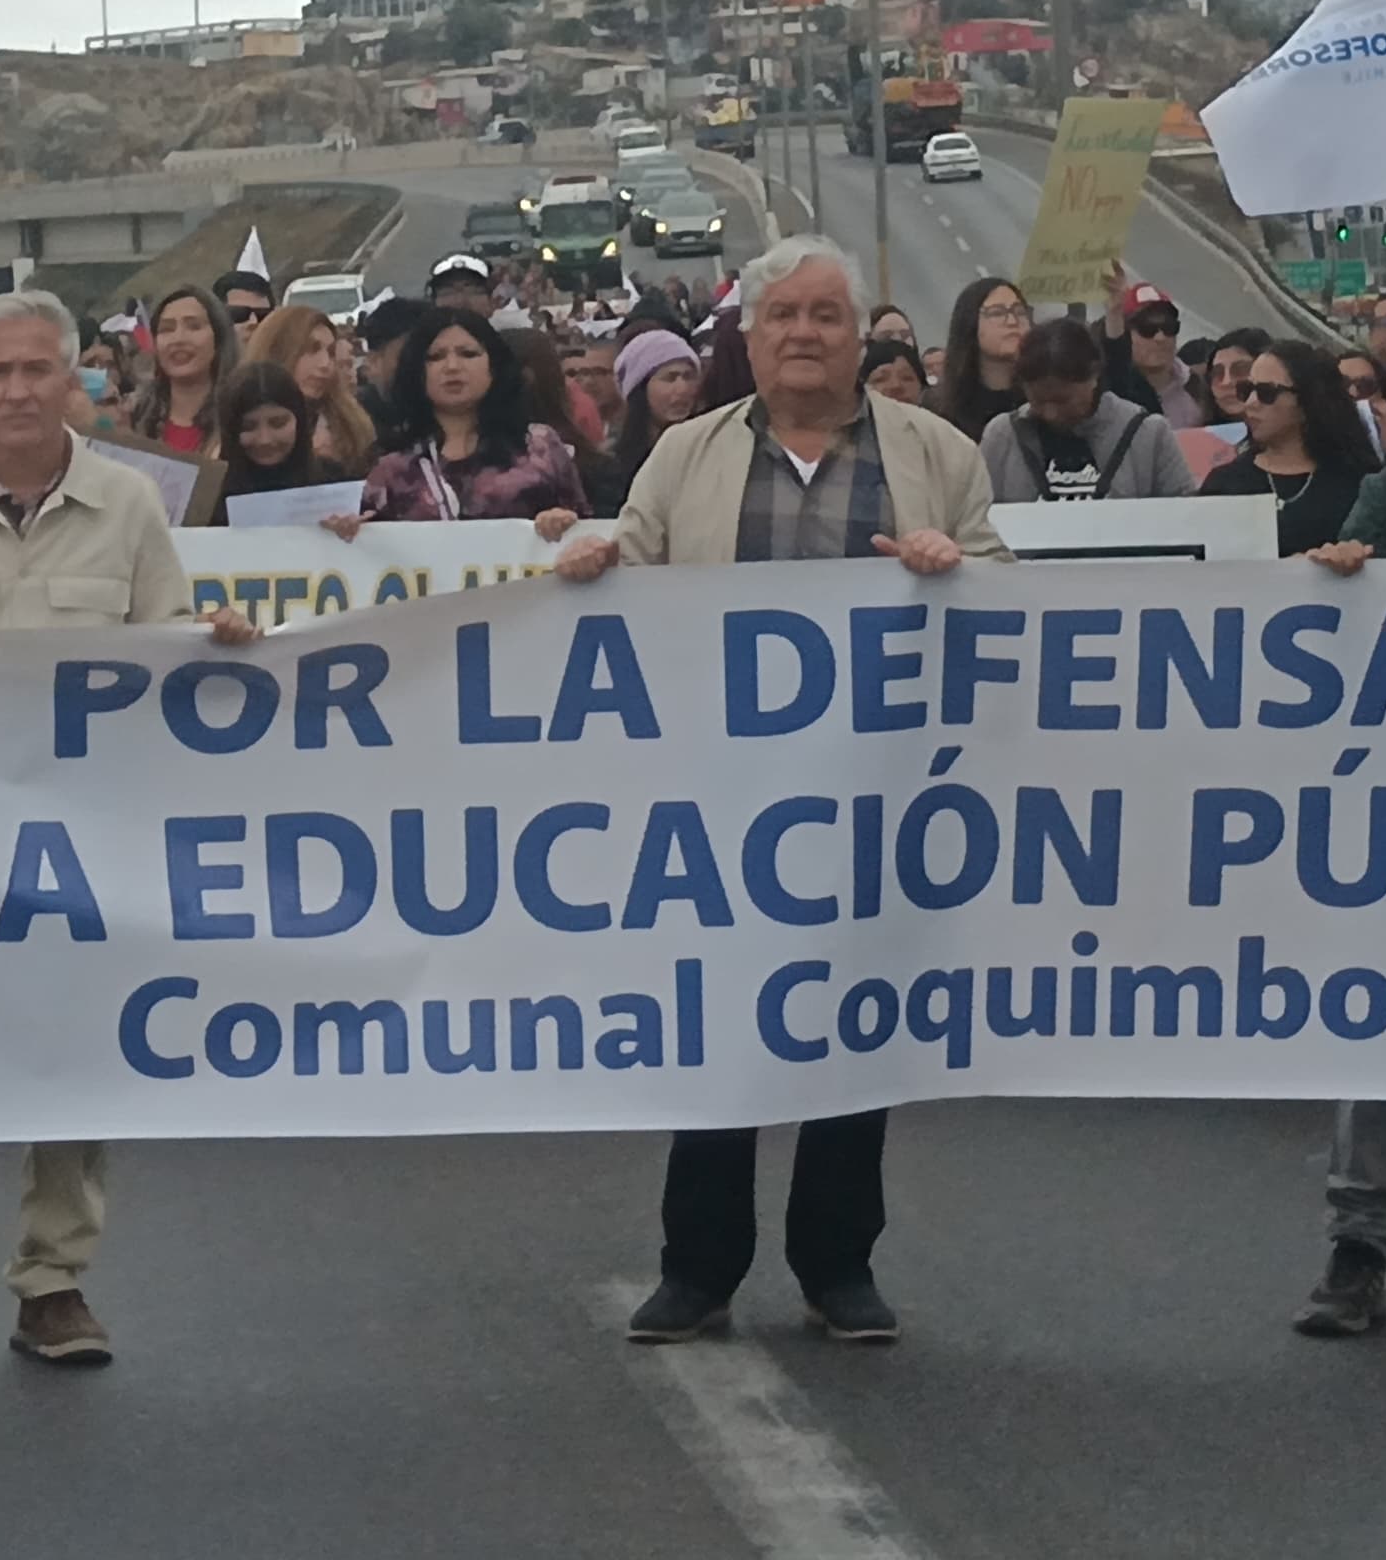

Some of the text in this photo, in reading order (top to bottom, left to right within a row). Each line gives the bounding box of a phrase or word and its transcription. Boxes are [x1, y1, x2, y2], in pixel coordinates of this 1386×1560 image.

[53, 643, 392, 760] POR
[455, 615, 662, 744] LA
[164, 747, 1122, 942] EDUCACIÓN
[120, 957, 705, 1080] Comunal
